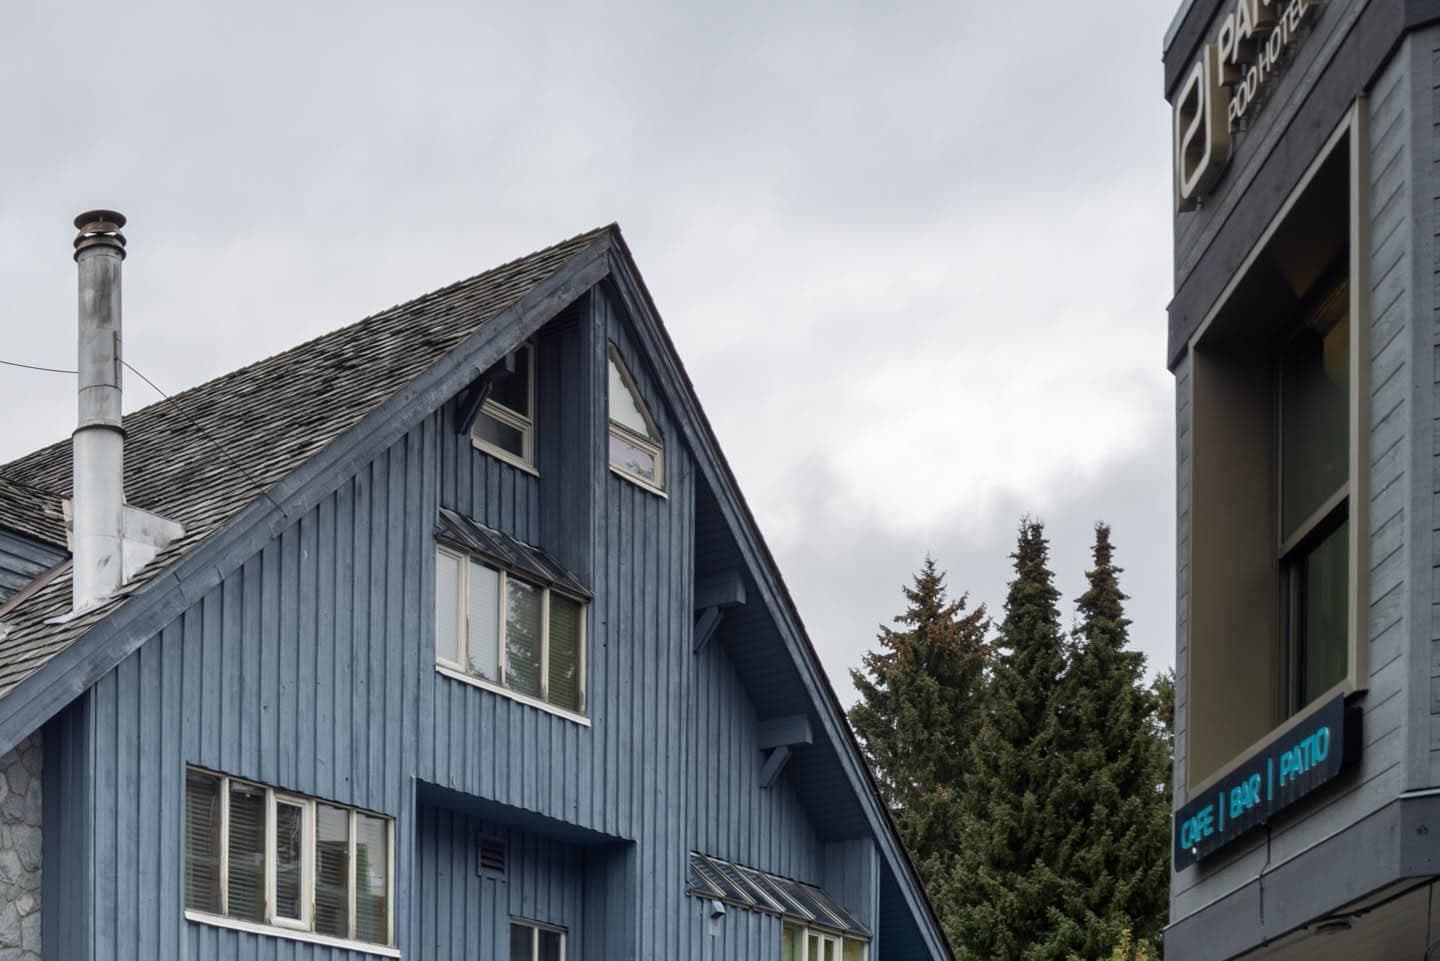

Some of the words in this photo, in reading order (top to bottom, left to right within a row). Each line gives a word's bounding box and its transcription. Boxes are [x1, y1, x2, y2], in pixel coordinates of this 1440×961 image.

[1228, 66, 1257, 135] POD
[1258, 0, 1309, 83] HOTEL
[1229, 773, 1262, 819] BAR
[1280, 726, 1330, 787] PATIO
